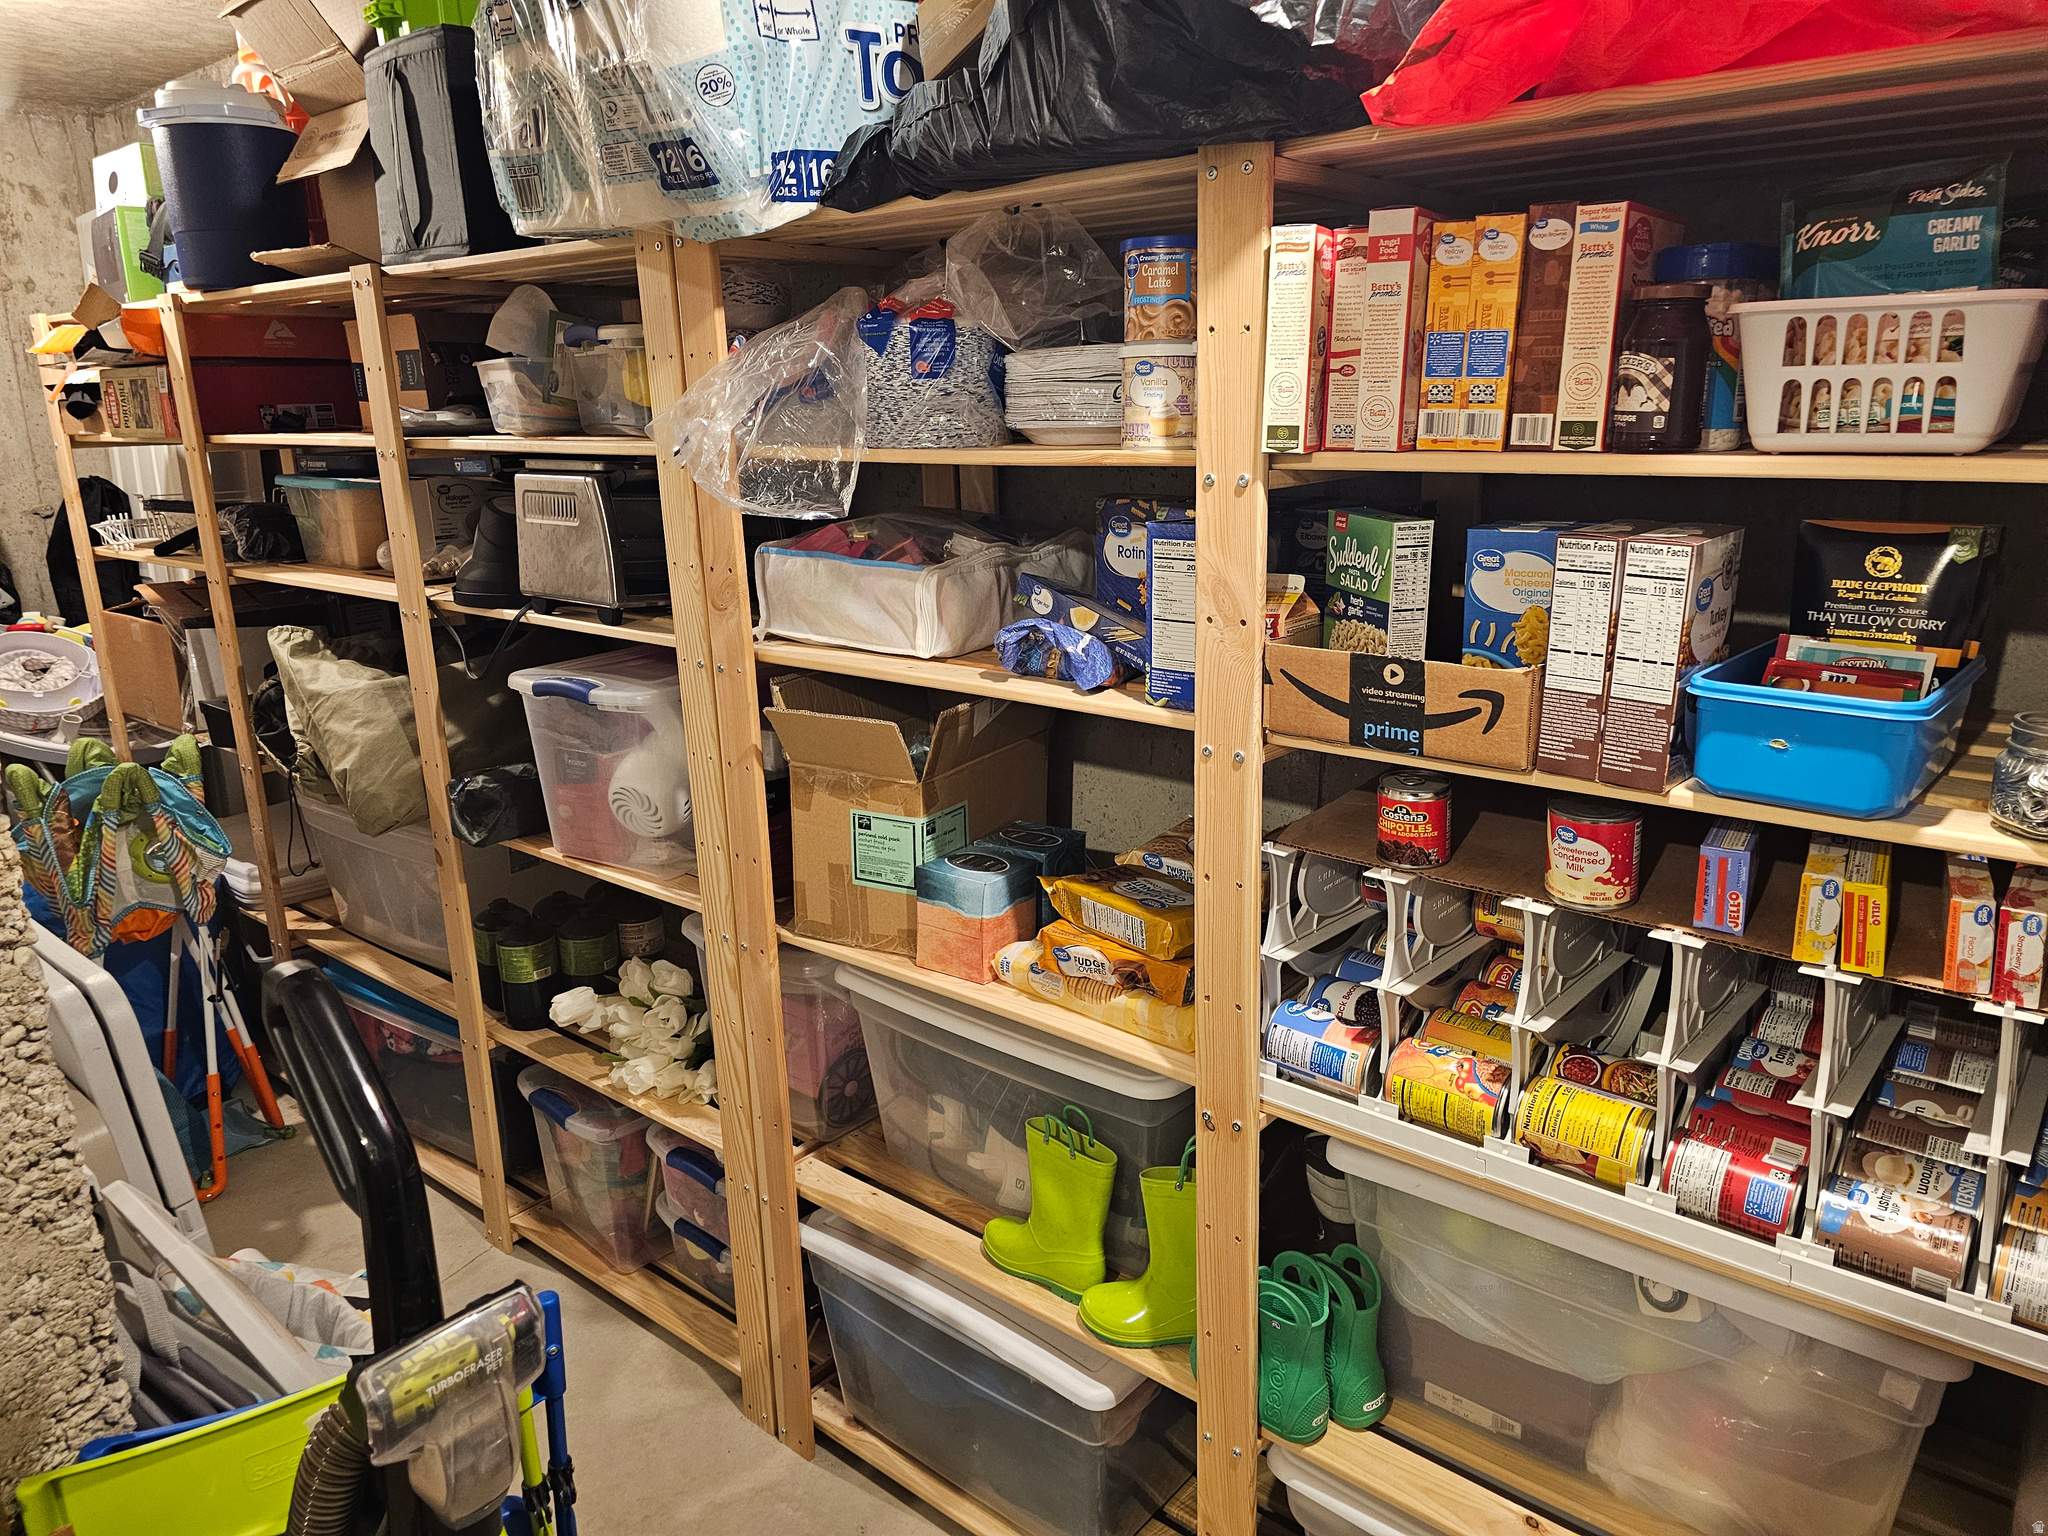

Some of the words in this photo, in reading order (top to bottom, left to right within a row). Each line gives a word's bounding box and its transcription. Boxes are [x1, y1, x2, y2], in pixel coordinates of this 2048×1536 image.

[785, 25, 811, 36] Whole
[699, 75, 733, 97] 20%
[656, 149, 681, 174] 12
[776, 159, 797, 185] 12
[1908, 187, 1944, 205] Pasta
[1579, 207, 1600, 216] Super
[1589, 223, 1609, 231] White
[1927, 214, 1984, 236] CREAMY
[1795, 220, 1881, 254] Knorr
[1933, 233, 1981, 254] GARLIC
[1379, 246, 1399, 254] Food
[1443, 248, 1465, 256] Yellow
[1487, 243, 1509, 251] Yellow
[1579, 241, 1614, 253] Betty's
[1139, 254, 1159, 263] Creamy
[1159, 253, 1185, 262] Supreme
[1576, 250, 1614, 263] promise
[1141, 261, 1179, 276] Caramel
[1276, 260, 1308, 271] Betty's
[1884, 261, 1913, 271] Pasta
[1915, 260, 1926, 268] in
[1936, 257, 1978, 269] Creamy
[1897, 269, 1942, 279] Flavored
[1943, 266, 1977, 277] Sauce
[1147, 276, 1172, 289] Latte
[1370, 281, 1402, 293] Betty's
[1133, 295, 1161, 305] FROSTING
[1368, 290, 1402, 302] promise
[1140, 379, 1168, 387] Vanilla
[117, 379, 132, 430] PORTABLE
[445, 493, 471, 503] Halogen
[1111, 520, 1128, 530] Great
[1300, 531, 1327, 542] Elbows
[1953, 527, 1978, 537] NEW
[1153, 539, 1181, 547] Nutrition
[1558, 540, 1592, 551] Nutrition
[1593, 541, 1616, 553] Facts
[1117, 543, 1146, 561] Rotin
[1629, 543, 1665, 556] Nutrition
[1665, 546, 1690, 559] Facts
[1328, 535, 1391, 593] Suddenly!
[1476, 552, 1501, 564] Great
[1482, 560, 1500, 569] Value
[1339, 572, 1369, 592] SALAD
[1503, 578, 1512, 587] &
[1513, 577, 1552, 589] Cheese
[1555, 579, 1577, 587] Calories
[1582, 580, 1596, 589] 110
[1597, 580, 1611, 590] 180
[1830, 579, 1864, 590] BLUE
[1863, 580, 1931, 594] ELEPHANT
[1512, 587, 1552, 599] Original
[1624, 584, 1648, 593] Calories
[1653, 586, 1667, 595] 110
[1670, 587, 1684, 596] 180
[1837, 589, 1864, 601] Royal
[1864, 590, 1885, 601] Thai
[1349, 594, 1364, 607] herb
[1347, 606, 1364, 618] garlic
[1823, 600, 1867, 612] Premium
[1868, 603, 1896, 615] Curry
[1897, 605, 1929, 616] Sauce
[1709, 606, 1729, 627] Turkey
[1806, 610, 1837, 623] THAI
[1839, 613, 1896, 627] YELLOW
[1897, 617, 1947, 632] CURRY
[1361, 685, 1385, 697] video
[1384, 688, 1426, 704] streaming
[1367, 696, 1386, 706] movies
[1386, 698, 1397, 706] and
[1403, 700, 1419, 709] shows
[1363, 720, 1420, 745] prime
[1383, 808, 1424, 823] Costeña
[1397, 805, 1407, 814] La
[1379, 817, 1433, 834] CHIPOTLES
[877, 833, 888, 841] cold
[1552, 847, 1606, 865] Condensed
[1557, 843, 1599, 858] Sweetened
[1144, 854, 1160, 863] Great
[1165, 864, 1188, 877] TWIST
[1565, 861, 1586, 873] Milk
[1829, 881, 1838, 898] Great
[1813, 898, 1825, 931] Pineapple
[1982, 906, 1990, 923] Great
[2032, 916, 2040, 933] Great
[1966, 935, 1977, 959] Peach
[2013, 934, 2026, 971] Strawberry
[1054, 950, 1068, 958] Great
[999, 955, 1008, 978] FAMILY
[1073, 955, 1107, 971] FUDGE
[1522, 1094, 1540, 1131] Nutrition
[1534, 1078, 1549, 1096] Facts
[1549, 1109, 1562, 1139] Calories
[1561, 1085, 1574, 1098] 120
[425, 1347, 504, 1399] TURBOERASER
[486, 1357, 504, 1376] PET
